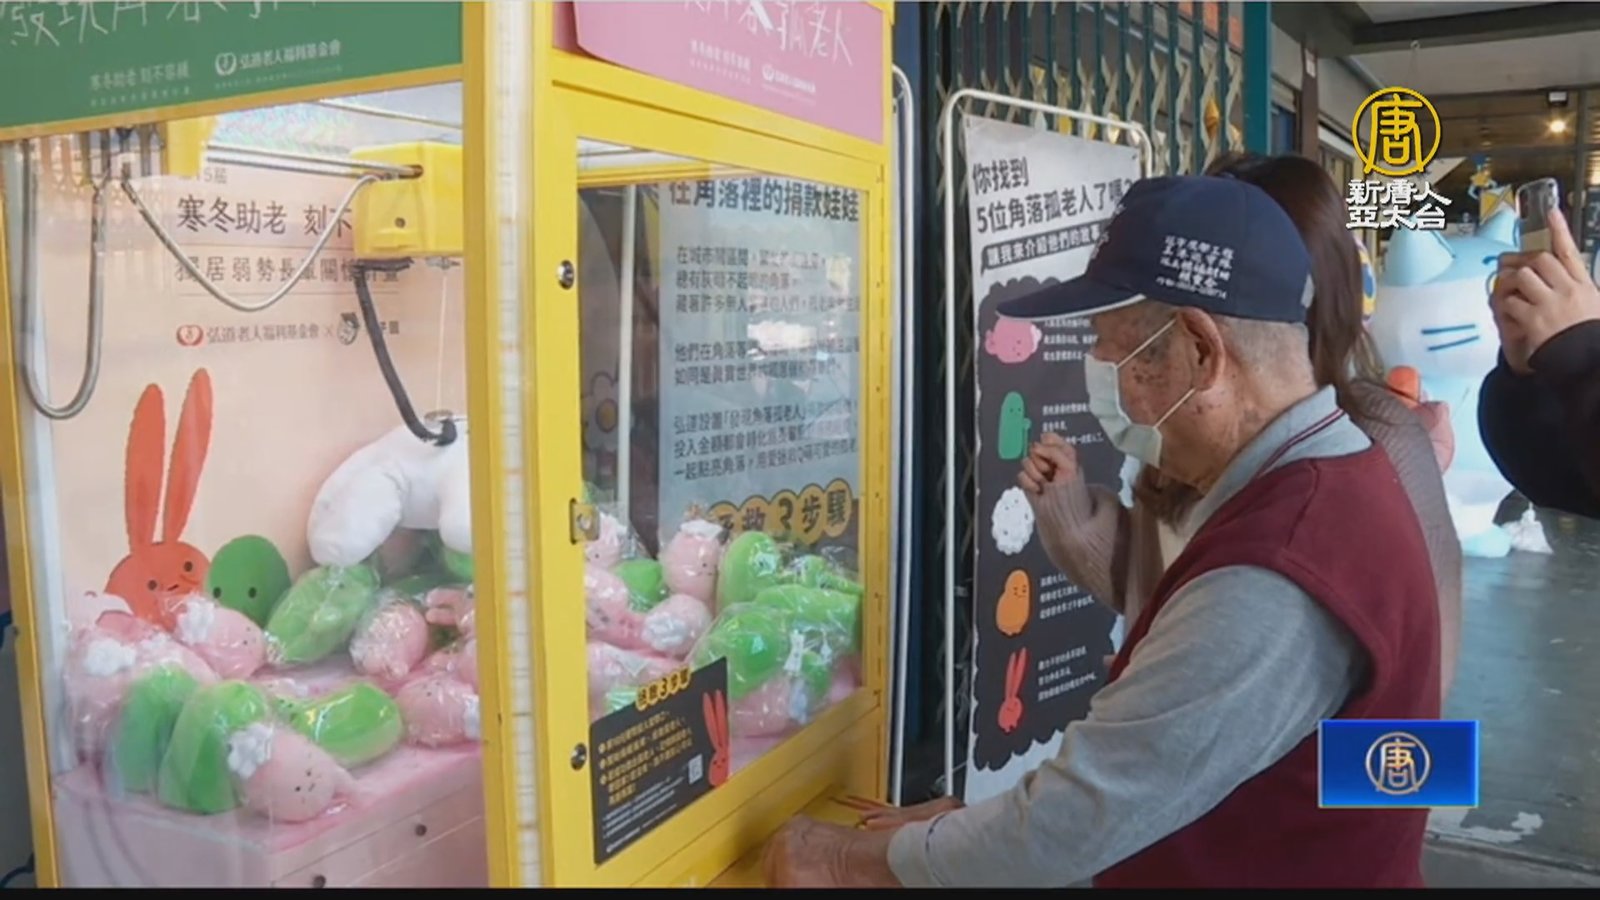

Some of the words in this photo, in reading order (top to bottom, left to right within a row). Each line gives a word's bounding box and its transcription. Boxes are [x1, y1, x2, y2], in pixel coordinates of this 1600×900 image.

[972, 156, 1029, 195] 你找到
[177, 195, 287, 235] 寒冬助老
[987, 223, 1101, 266] 讓我來介紹他們的故事
[206, 324, 319, 344] 弘道老人福利基金會
